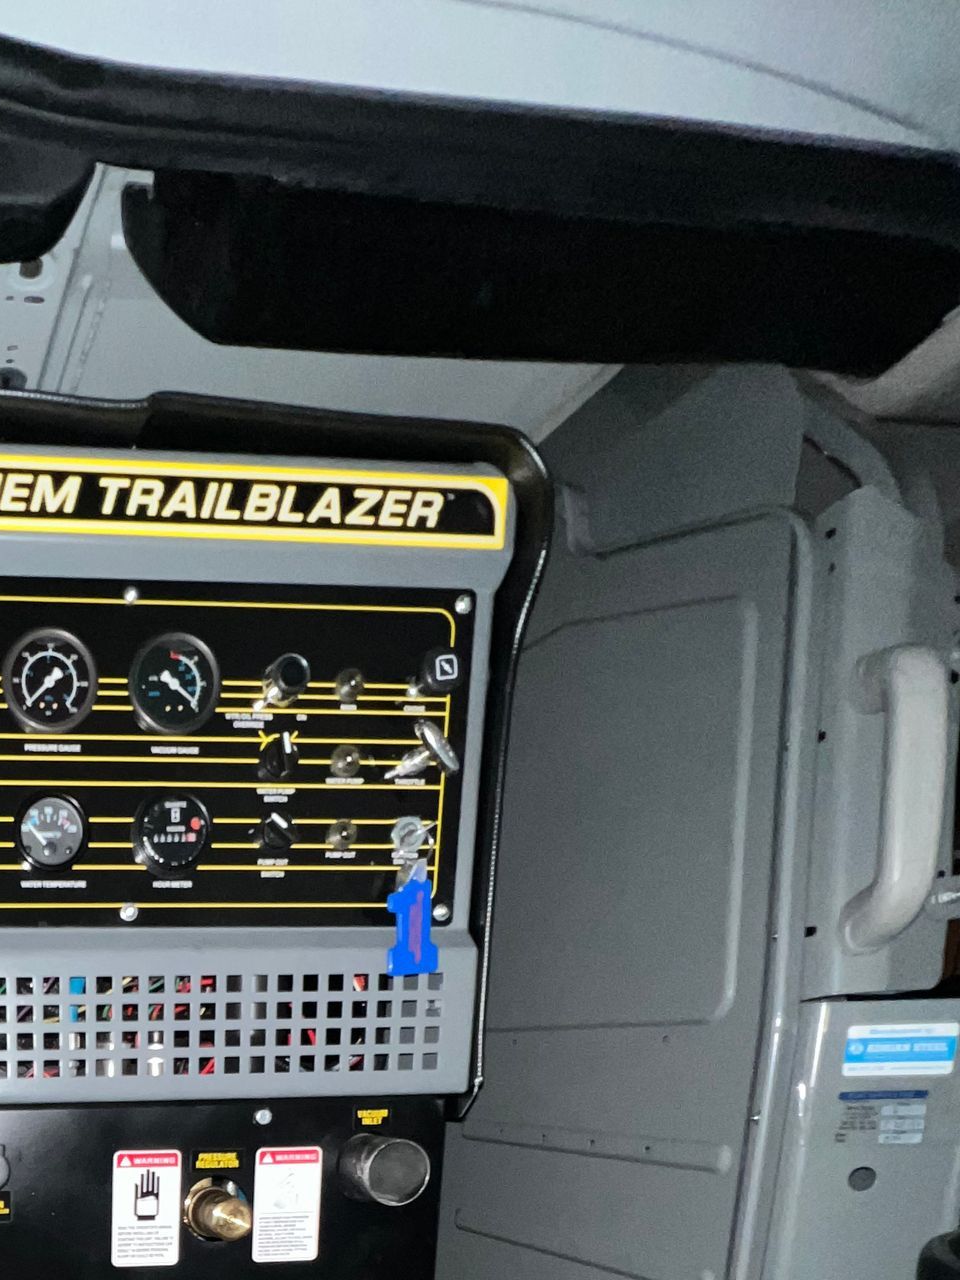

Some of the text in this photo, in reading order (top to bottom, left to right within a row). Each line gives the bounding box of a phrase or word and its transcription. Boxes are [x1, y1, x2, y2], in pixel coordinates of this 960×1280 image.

[98, 476, 444, 528] TRAILBLAZER
[24, 743, 82, 753] PRESSURE GAUGE
[150, 746, 200, 755] VACUUM GAUGE
[20, 880, 87, 889] WATER TEMPERATURE
[152, 880, 193, 889] HOUR METER
[357, 1109, 388, 1118] VACUUM
[361, 1117, 382, 1125] INLET
[133, 1157, 176, 1165] WARNING
[198, 1152, 238, 1161] PRESSURE
[274, 1153, 317, 1161] WARNING
[196, 1159, 239, 1169] REGULATOR
